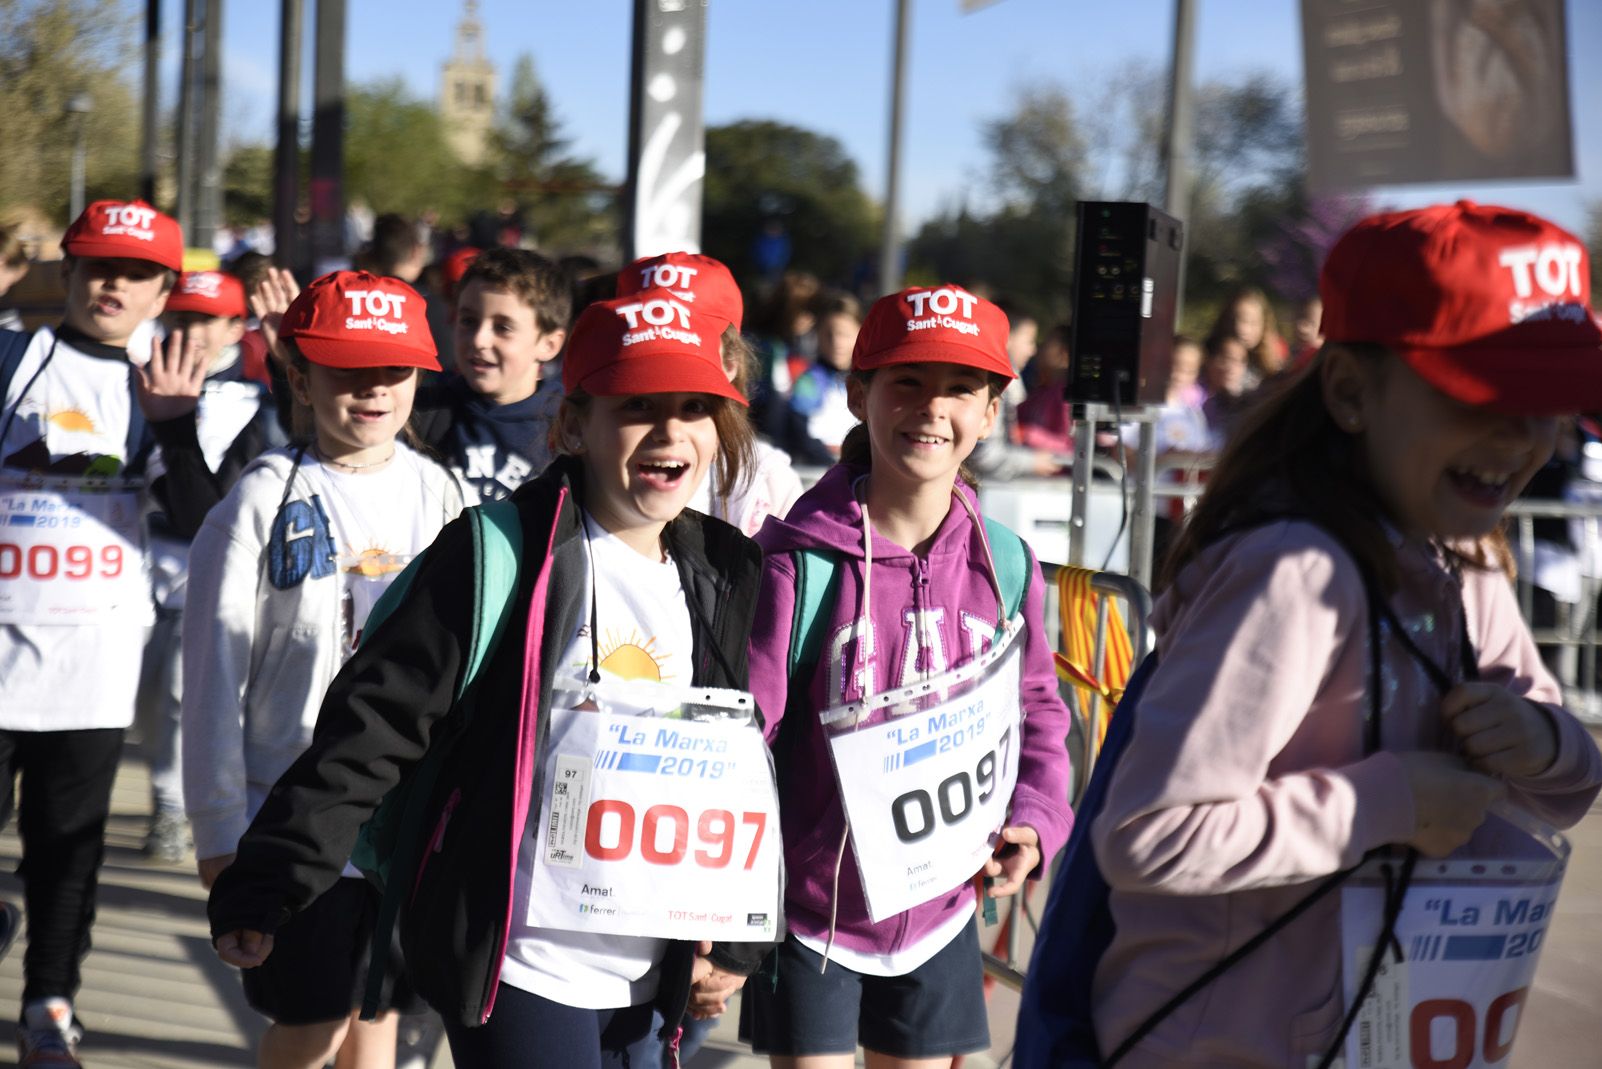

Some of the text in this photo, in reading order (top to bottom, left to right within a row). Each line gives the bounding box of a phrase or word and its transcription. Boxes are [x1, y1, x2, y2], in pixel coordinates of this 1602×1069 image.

[105, 205, 156, 229] TOT
[641, 264, 697, 289] TOT
[1498, 240, 1583, 298] TOT
[345, 290, 406, 319] TOT
[616, 299, 691, 330] TOT
[907, 288, 977, 319] TOT
[345, 317, 408, 335] Sant Cugat
[623, 326, 702, 347] Sant Cugat
[907, 316, 980, 336] Sant Cugat
[0, 543, 123, 580] 0099
[927, 699, 985, 735] Marxa
[654, 728, 728, 754] Marxa
[565, 769, 577, 779] 97
[891, 724, 1012, 845] 0097
[584, 799, 767, 871] 0097
[589, 904, 617, 916] ferrer
[668, 910, 688, 922] TOT
